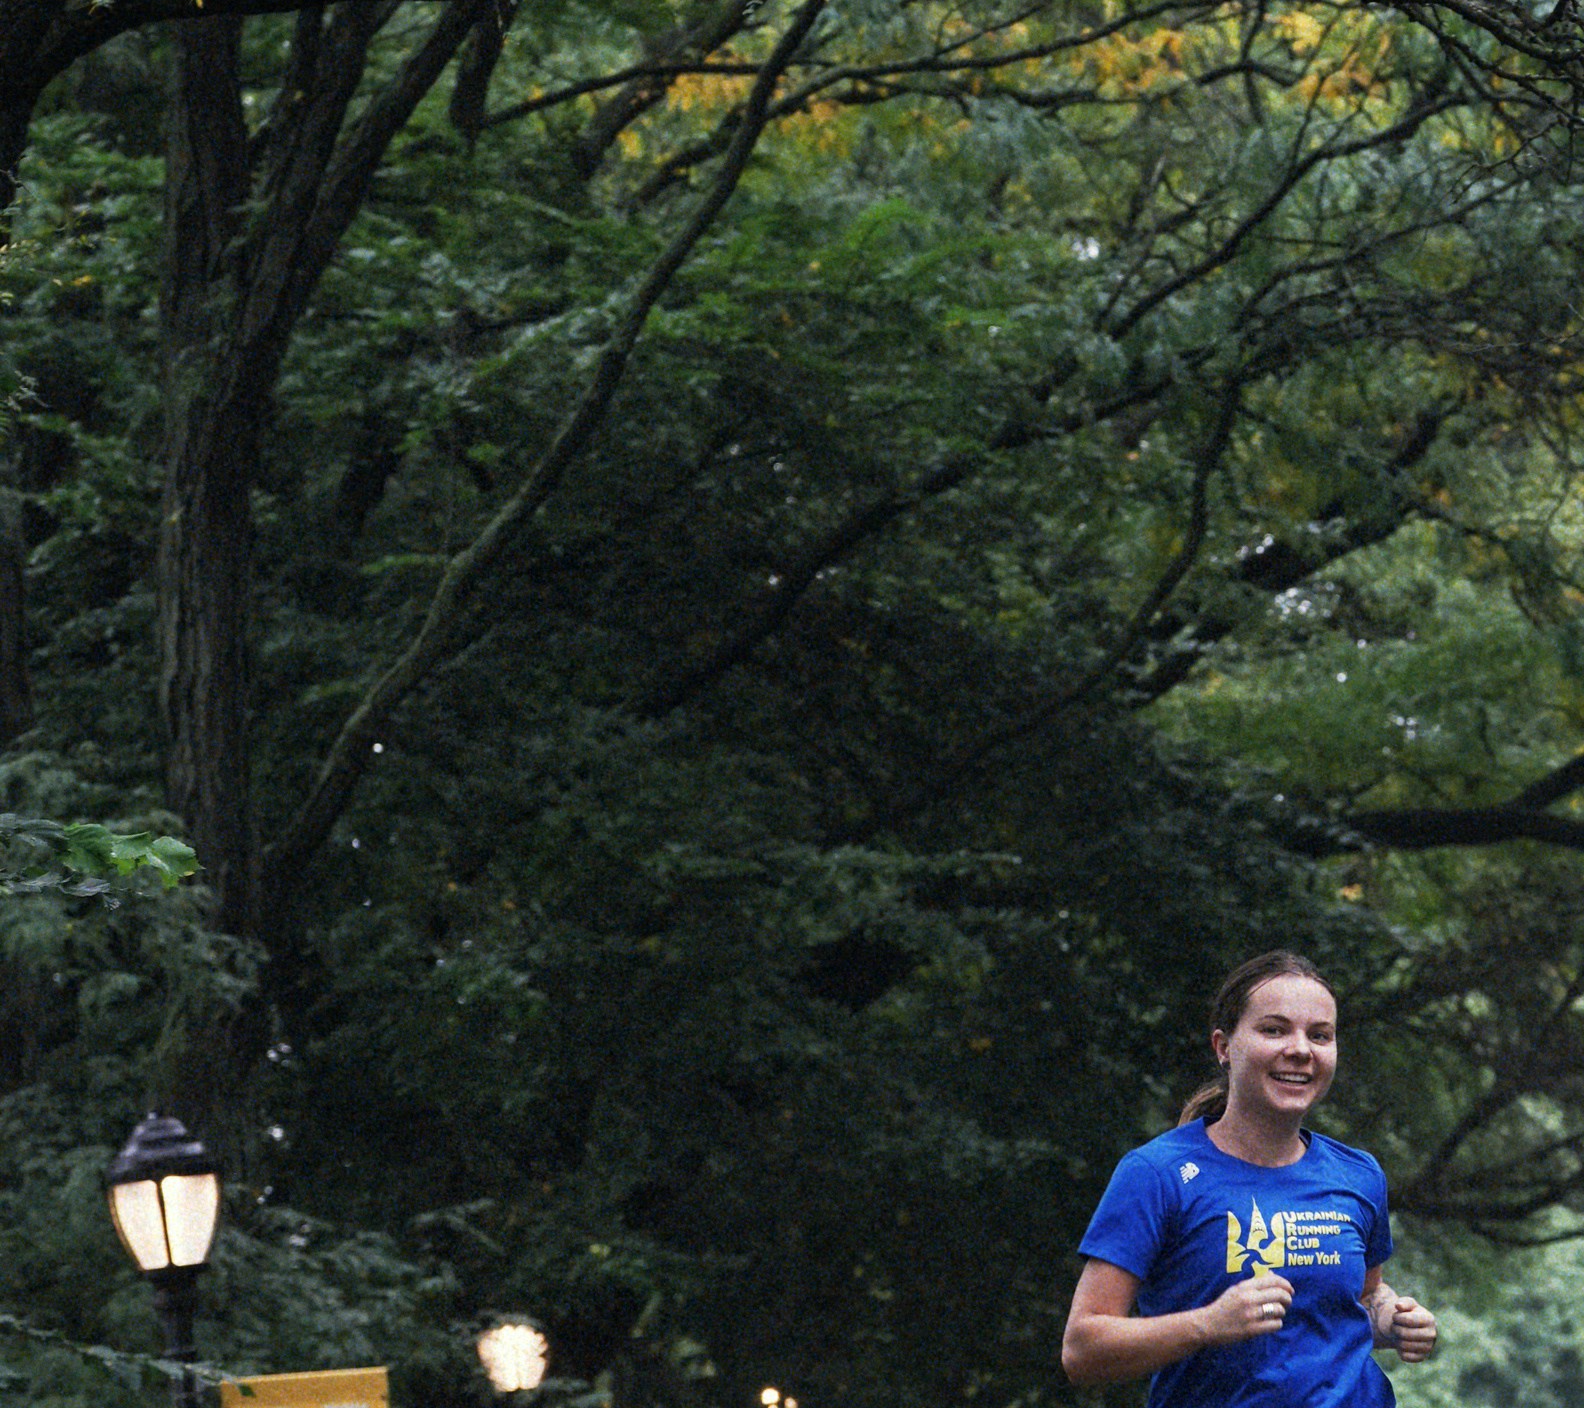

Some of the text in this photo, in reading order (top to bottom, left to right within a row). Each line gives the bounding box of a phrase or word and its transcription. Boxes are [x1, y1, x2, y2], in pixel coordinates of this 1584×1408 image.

[1286, 1223, 1341, 1236] RUNNING
[1287, 1236, 1320, 1251] CLUB
[1288, 1250, 1341, 1267] New York
